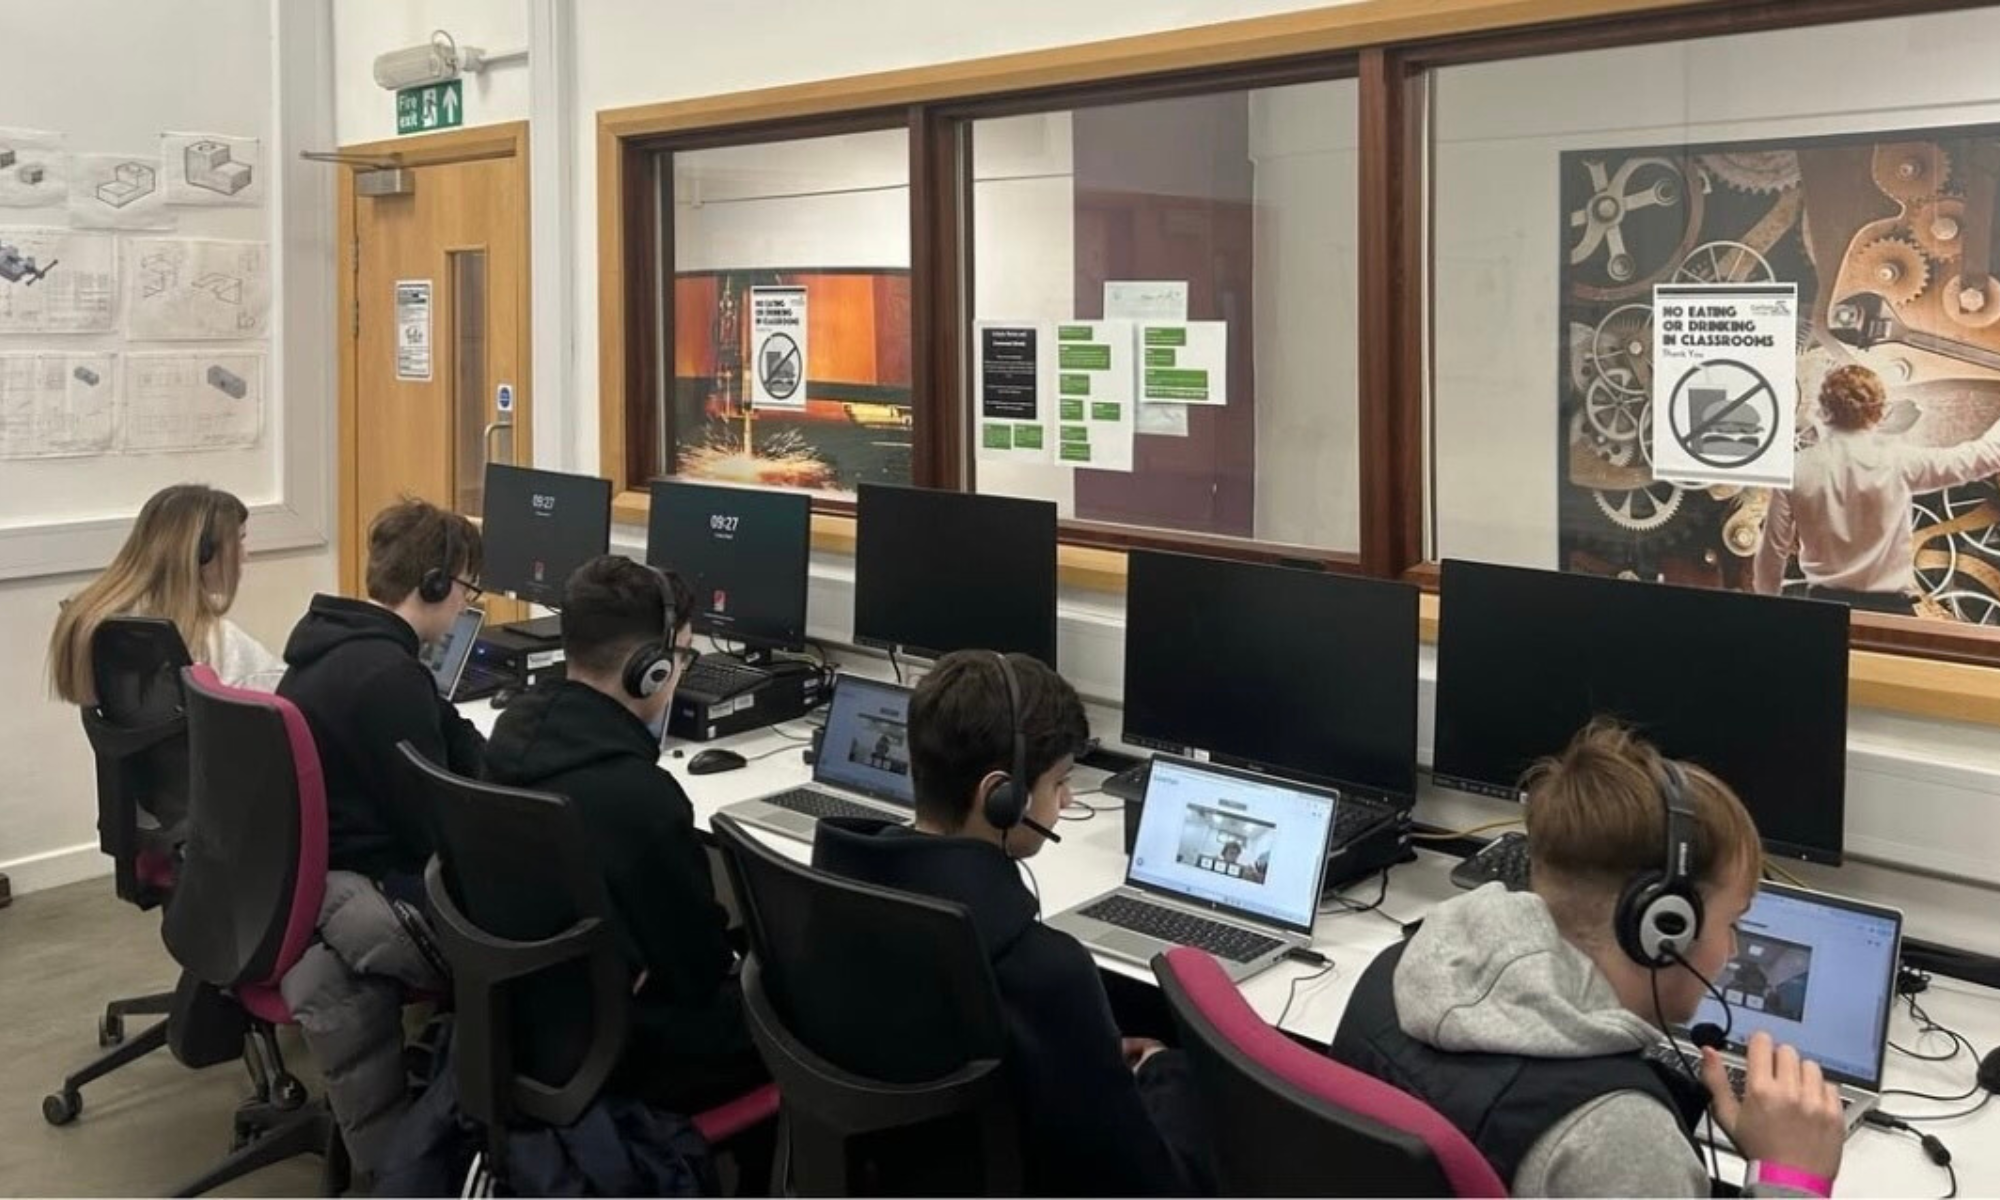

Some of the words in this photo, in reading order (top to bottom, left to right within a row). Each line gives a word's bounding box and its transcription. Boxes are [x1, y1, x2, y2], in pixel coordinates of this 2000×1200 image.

[399, 95, 418, 111] Fire
[399, 111, 418, 128] exit
[1663, 306, 1683, 317] NO
[1688, 306, 1737, 317] EATING
[1663, 321, 1683, 331] OR
[1688, 321, 1756, 332] DRINKING
[1663, 335, 1676, 346] IN
[1681, 335, 1774, 347] CLASSROOMS
[711, 514, 739, 530] 09:27
